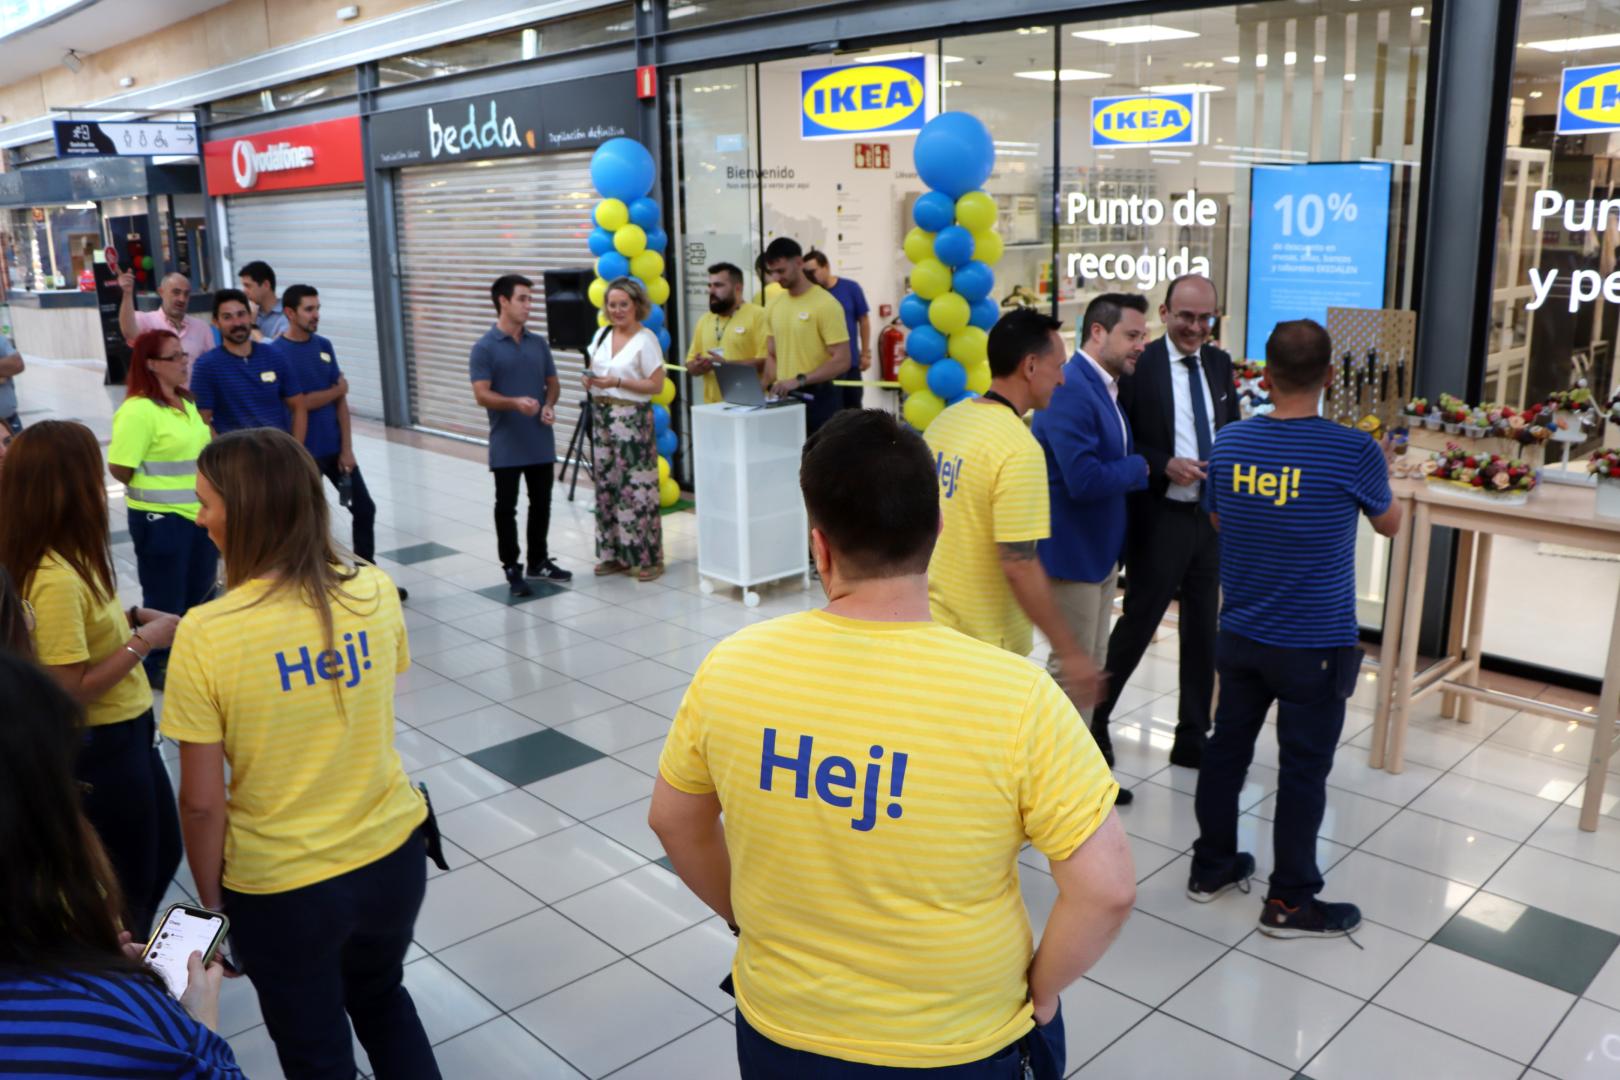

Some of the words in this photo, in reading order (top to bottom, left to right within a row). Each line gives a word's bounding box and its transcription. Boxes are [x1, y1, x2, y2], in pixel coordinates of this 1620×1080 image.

[813, 80, 914, 115] IKEA
[1102, 109, 1184, 130] IKEA
[253, 142, 315, 173] vodafone
[1067, 192, 1164, 225] Punto
[1173, 189, 1218, 226] de
[1273, 192, 1358, 237] 10%
[1531, 189, 1620, 232] Pun
[1067, 246, 1210, 290] recogida
[1525, 267, 1558, 311] y
[1569, 268, 1620, 313] pe
[1233, 463, 1302, 506] Hej!
[274, 630, 372, 692] Hej!
[760, 727, 908, 832] Hej!
